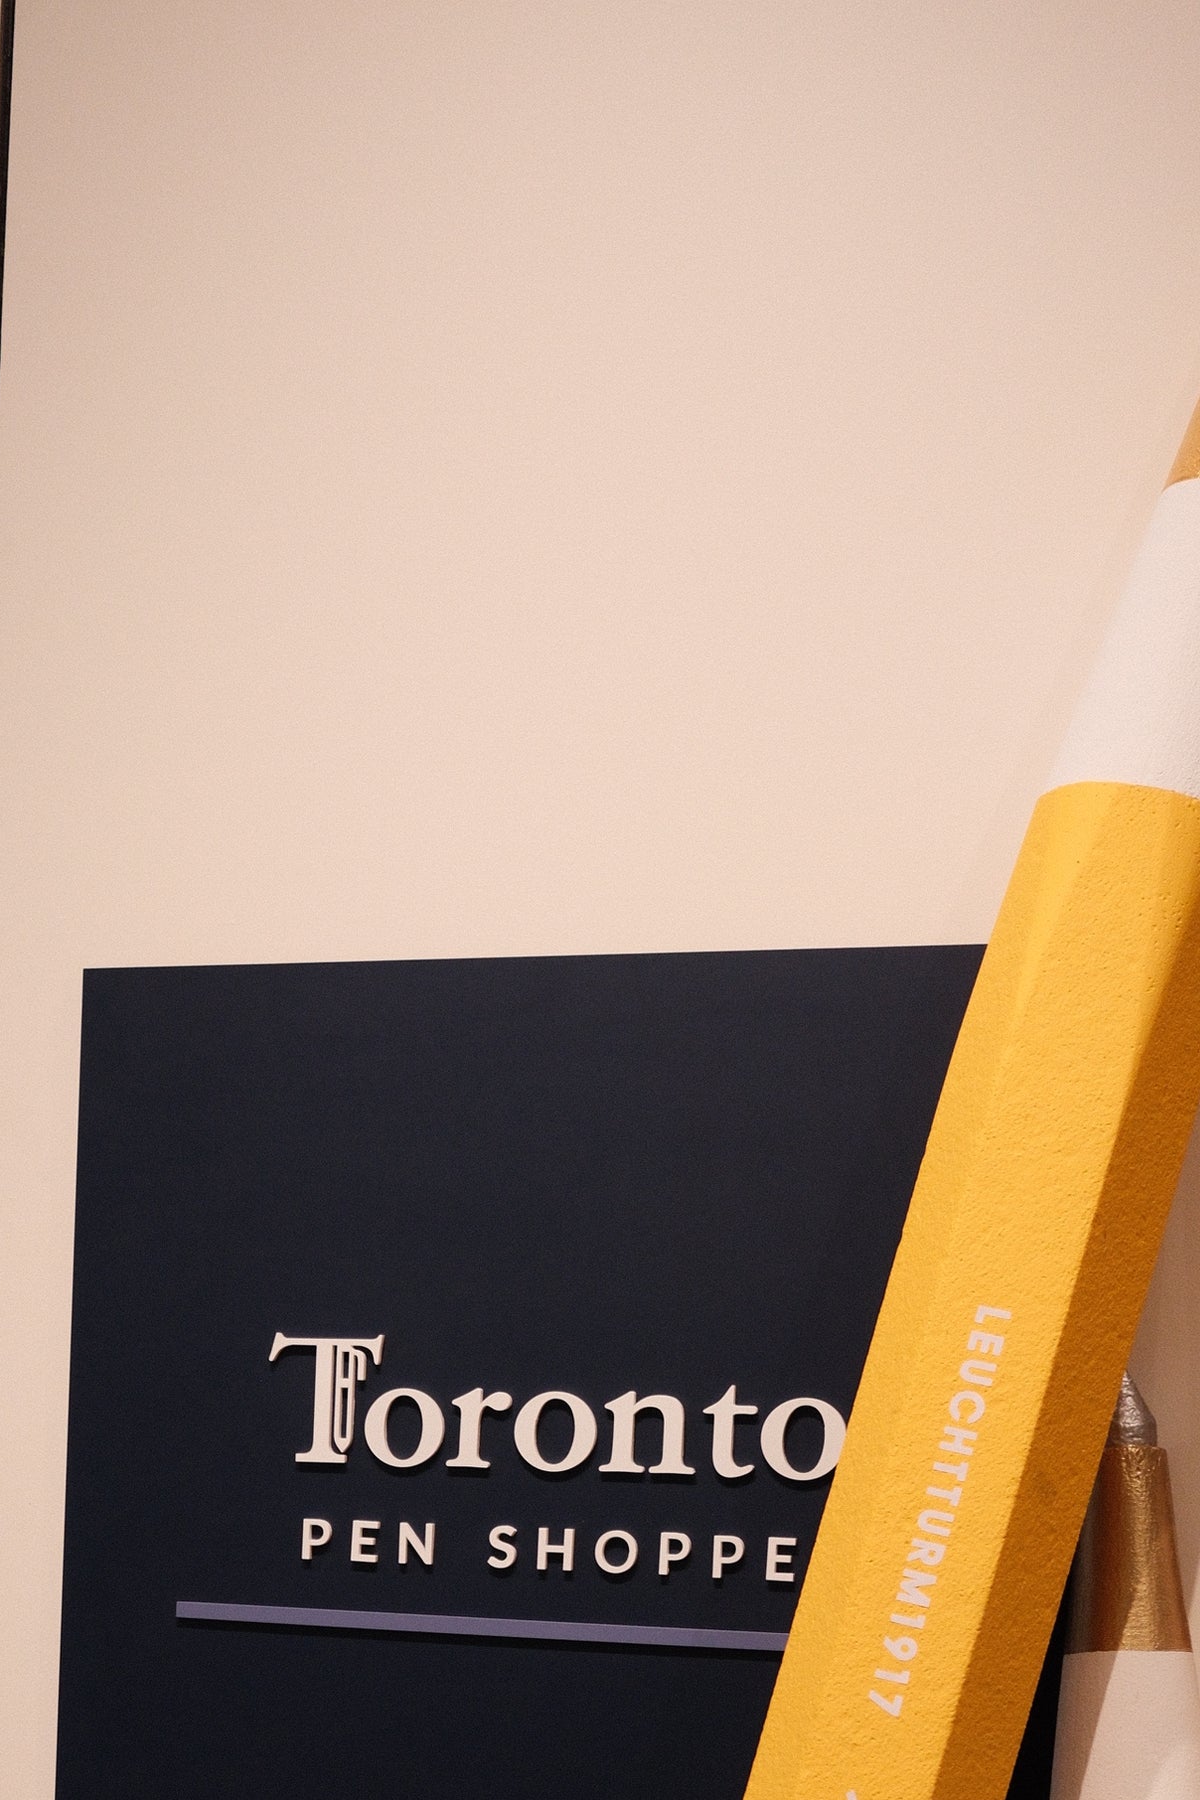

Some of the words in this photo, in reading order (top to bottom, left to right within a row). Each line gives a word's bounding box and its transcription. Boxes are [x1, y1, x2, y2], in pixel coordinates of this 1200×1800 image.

[268, 1332, 847, 1481] Toronto
[301, 1518, 436, 1565] PEN
[487, 1525, 798, 1583] SHOPPE
[868, 1304, 1012, 1718] LEUCHTTURM1917
